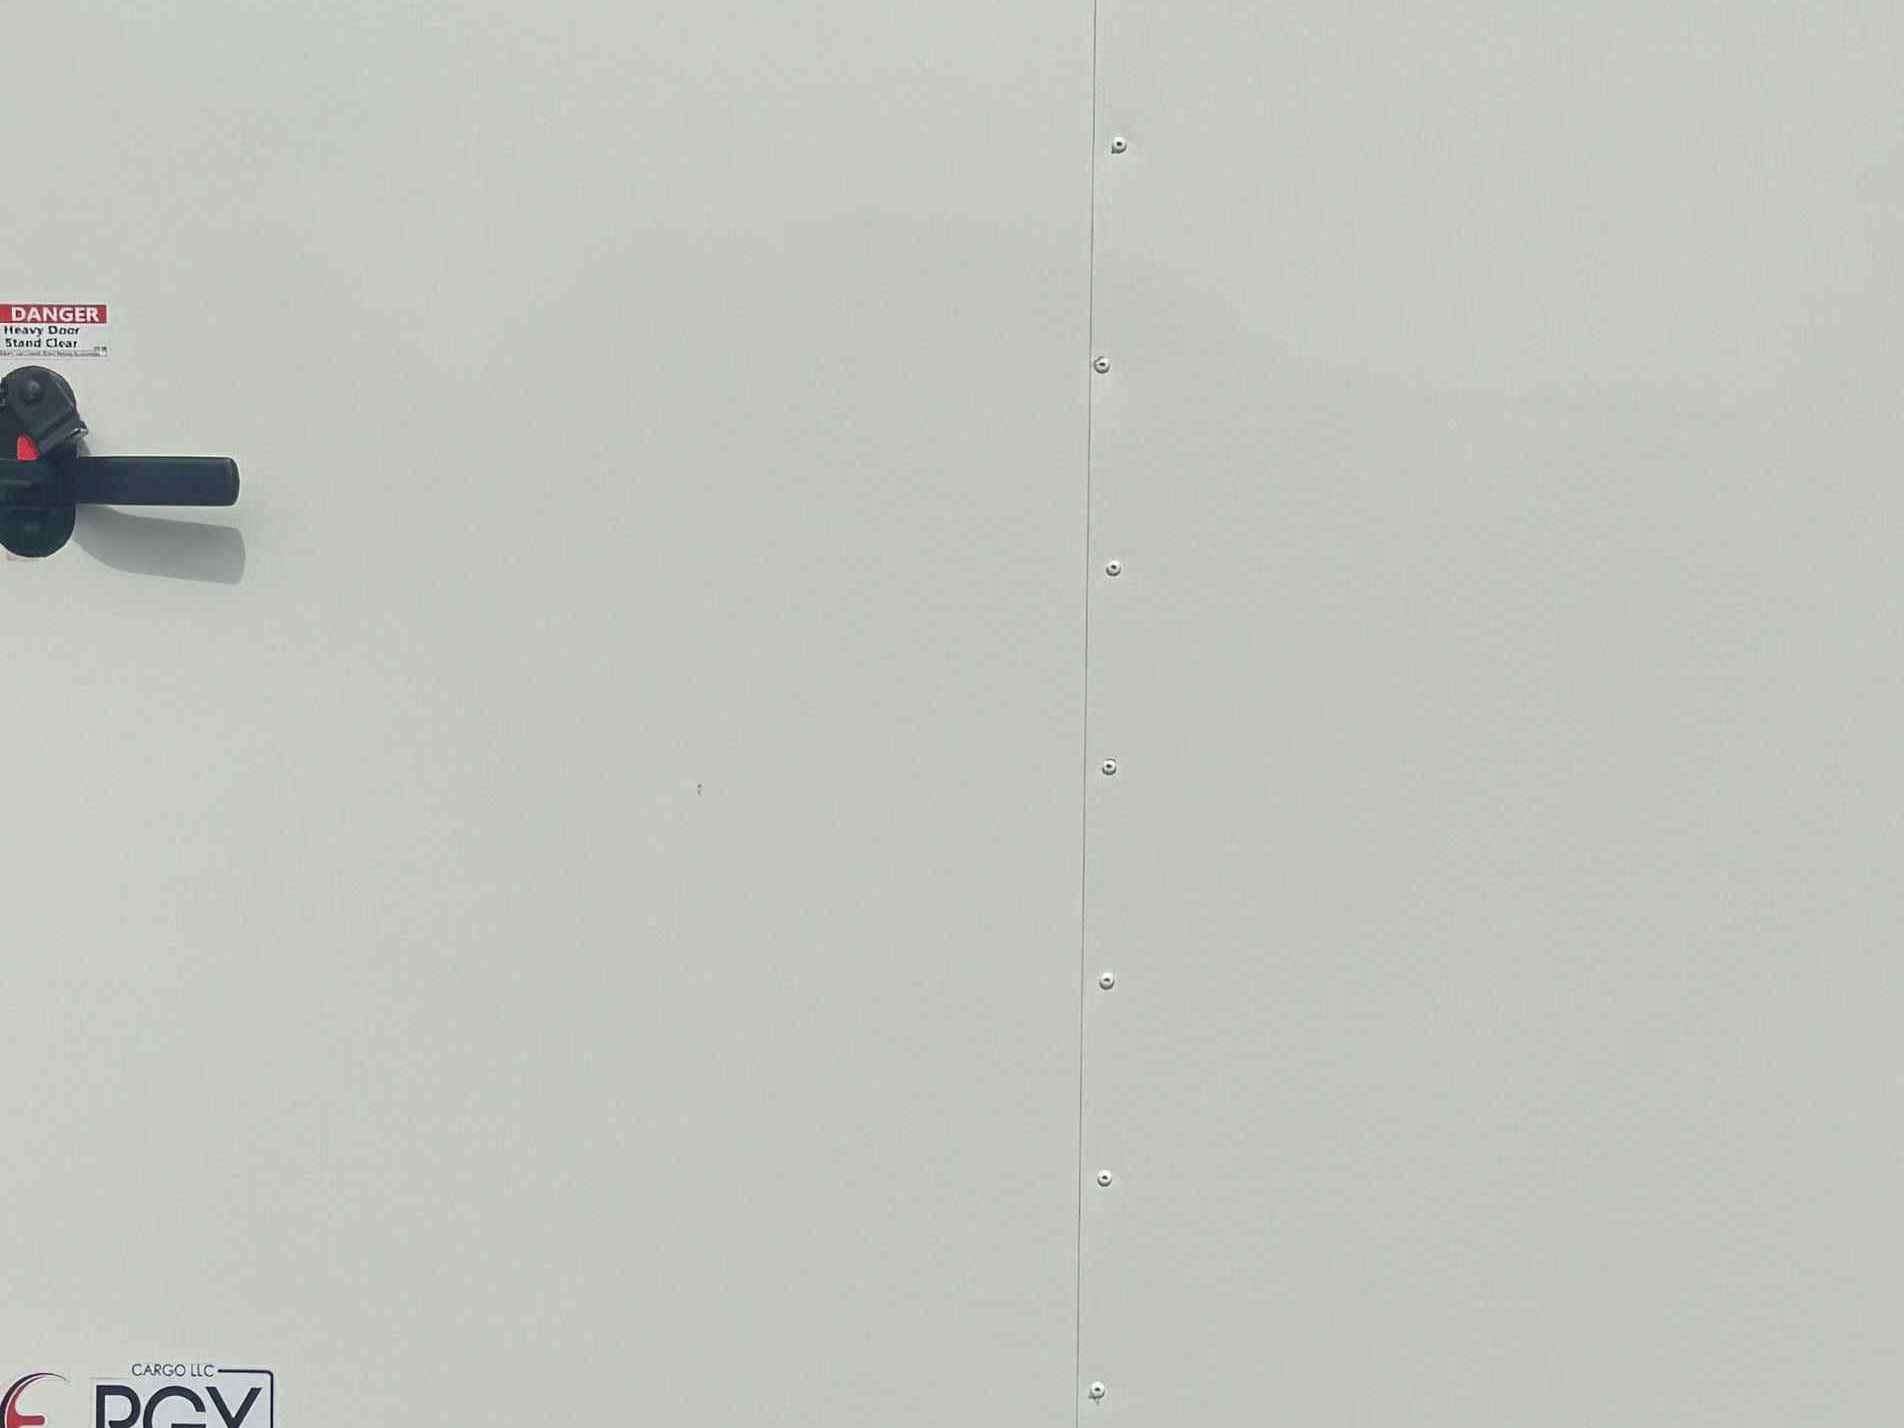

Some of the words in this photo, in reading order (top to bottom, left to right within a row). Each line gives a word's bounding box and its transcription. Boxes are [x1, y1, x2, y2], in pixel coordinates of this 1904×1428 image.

[10, 307, 99, 322] DANGER
[4, 325, 43, 336] Heavy
[48, 325, 80, 335] Door
[5, 338, 42, 348] Stand
[46, 338, 78, 348] Clear
[131, 1363, 186, 1377] CARGO
[191, 1363, 215, 1377] LLC
